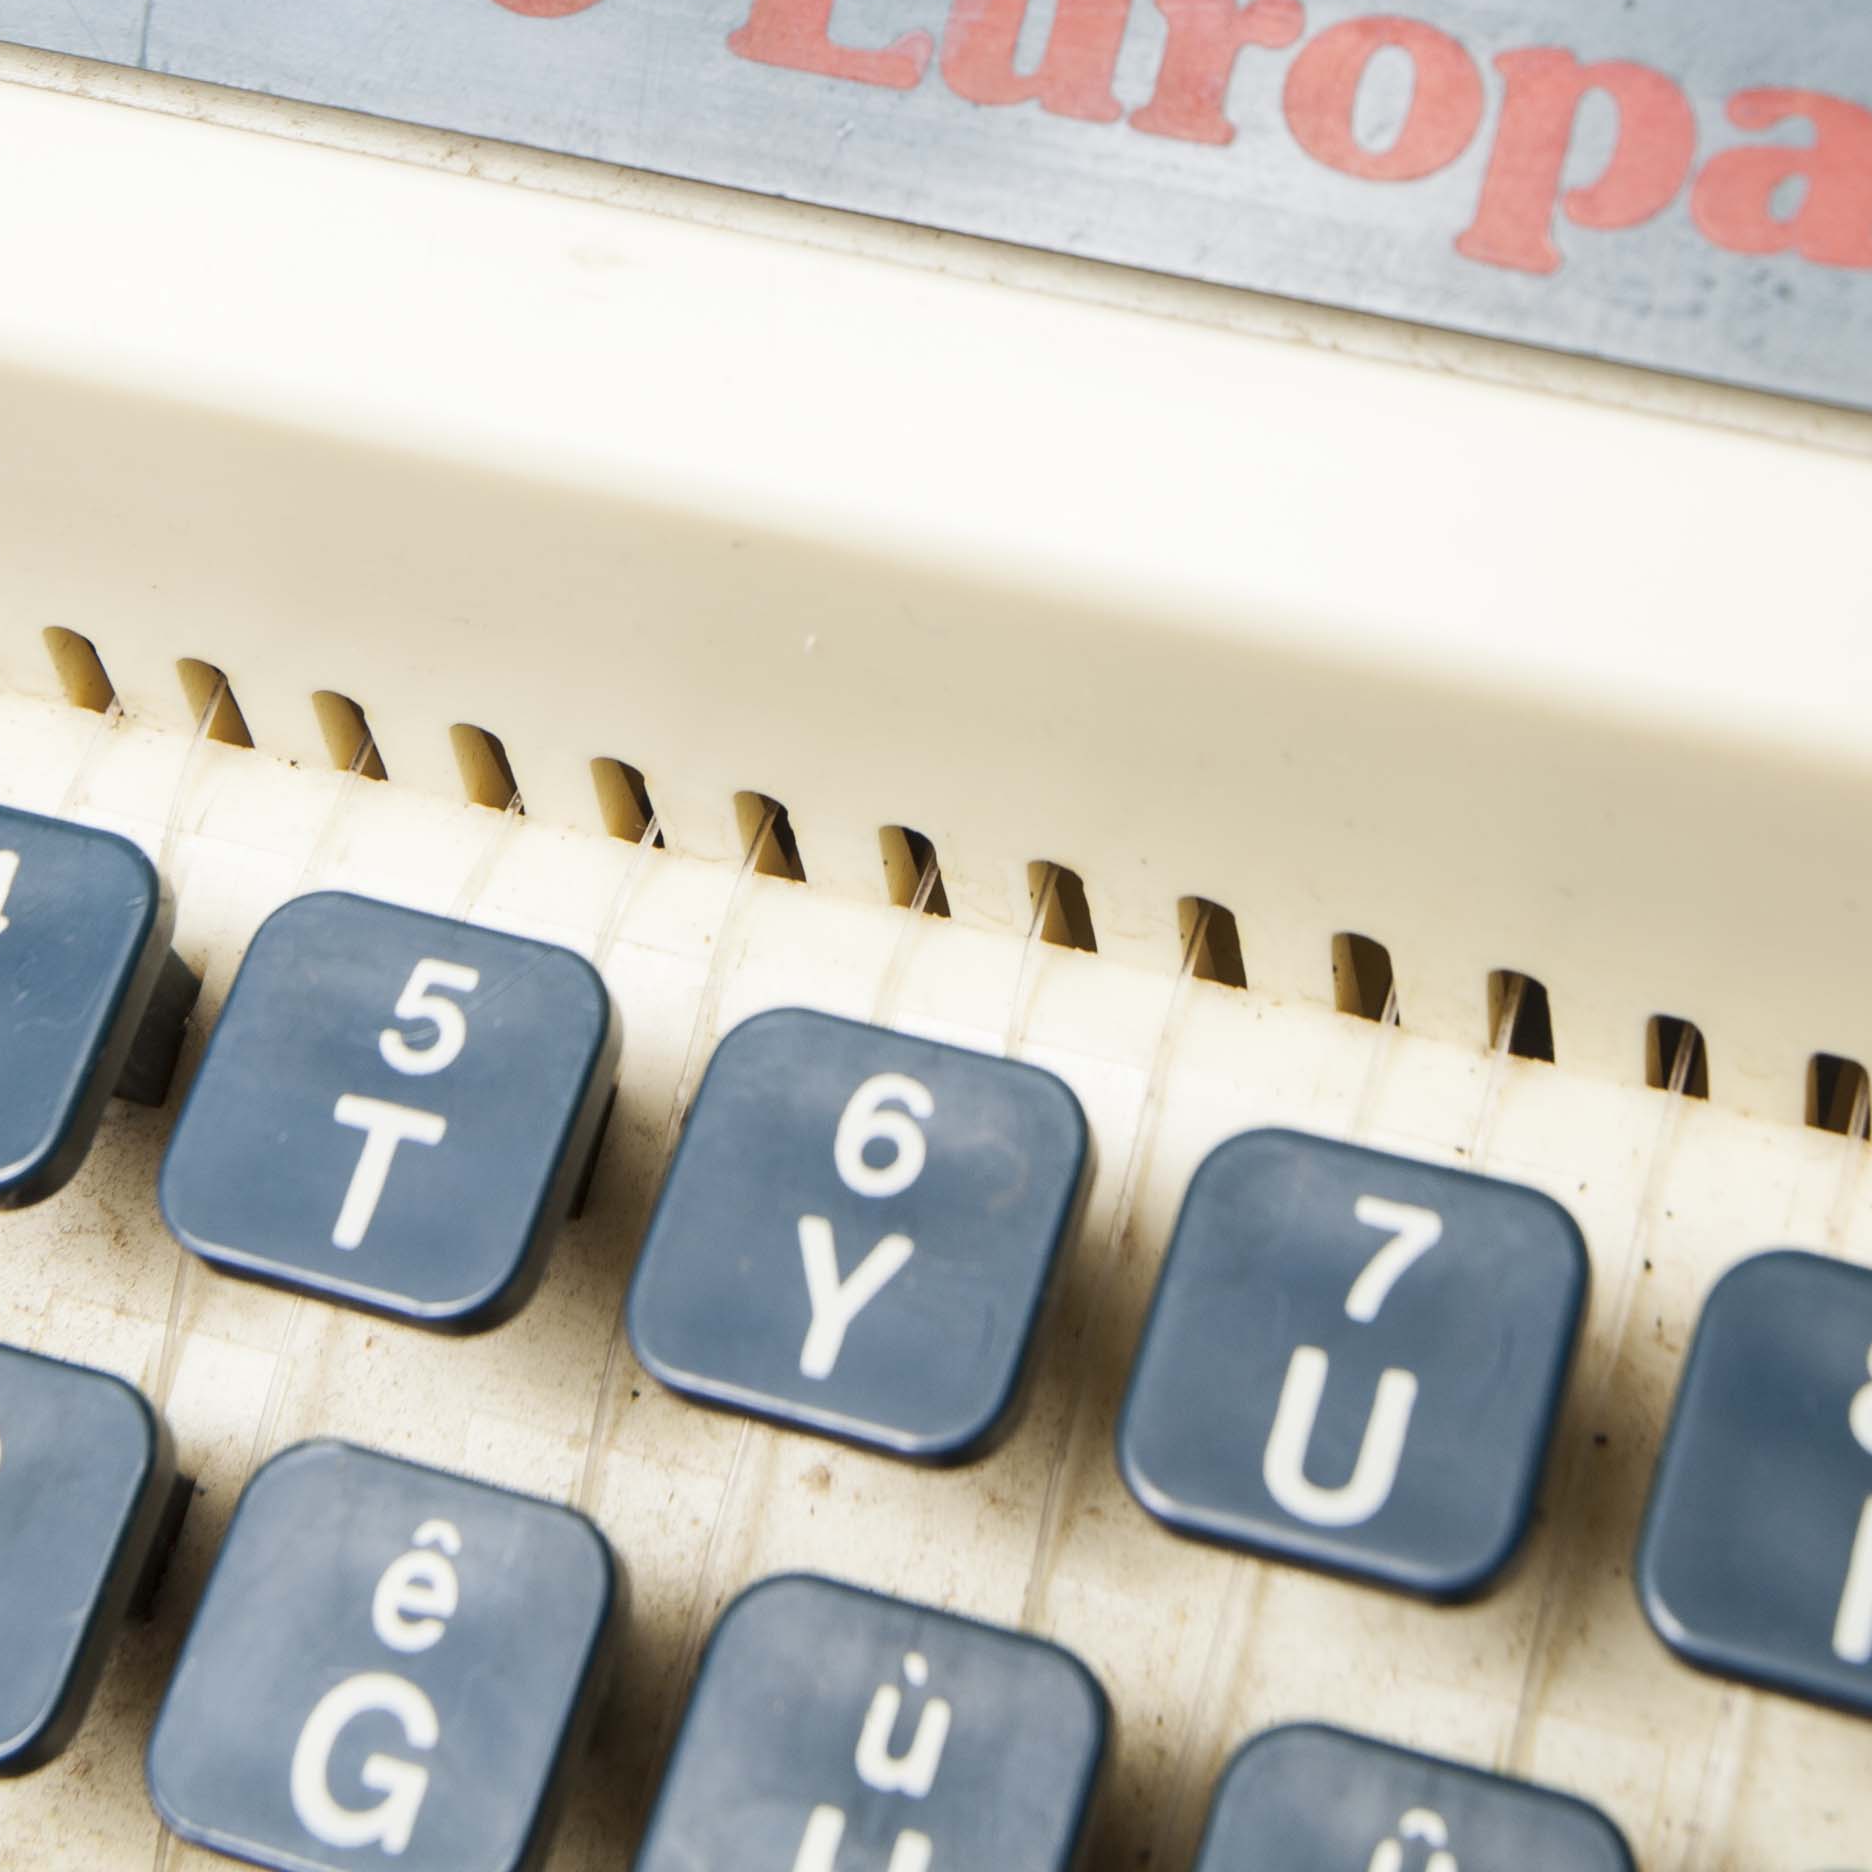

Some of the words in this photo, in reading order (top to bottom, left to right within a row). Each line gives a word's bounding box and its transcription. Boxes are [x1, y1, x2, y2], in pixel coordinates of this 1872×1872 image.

[378, 957, 481, 1075] 5
[331, 1092, 448, 1250] T
[833, 1071, 936, 1197] 6
[797, 1214, 915, 1380] Y
[1344, 1193, 1444, 1322] 7
[1262, 1345, 1418, 1526] U
[371, 1517, 463, 1651] ê
[290, 1671, 440, 1854] G
[854, 1651, 952, 1796] ù
